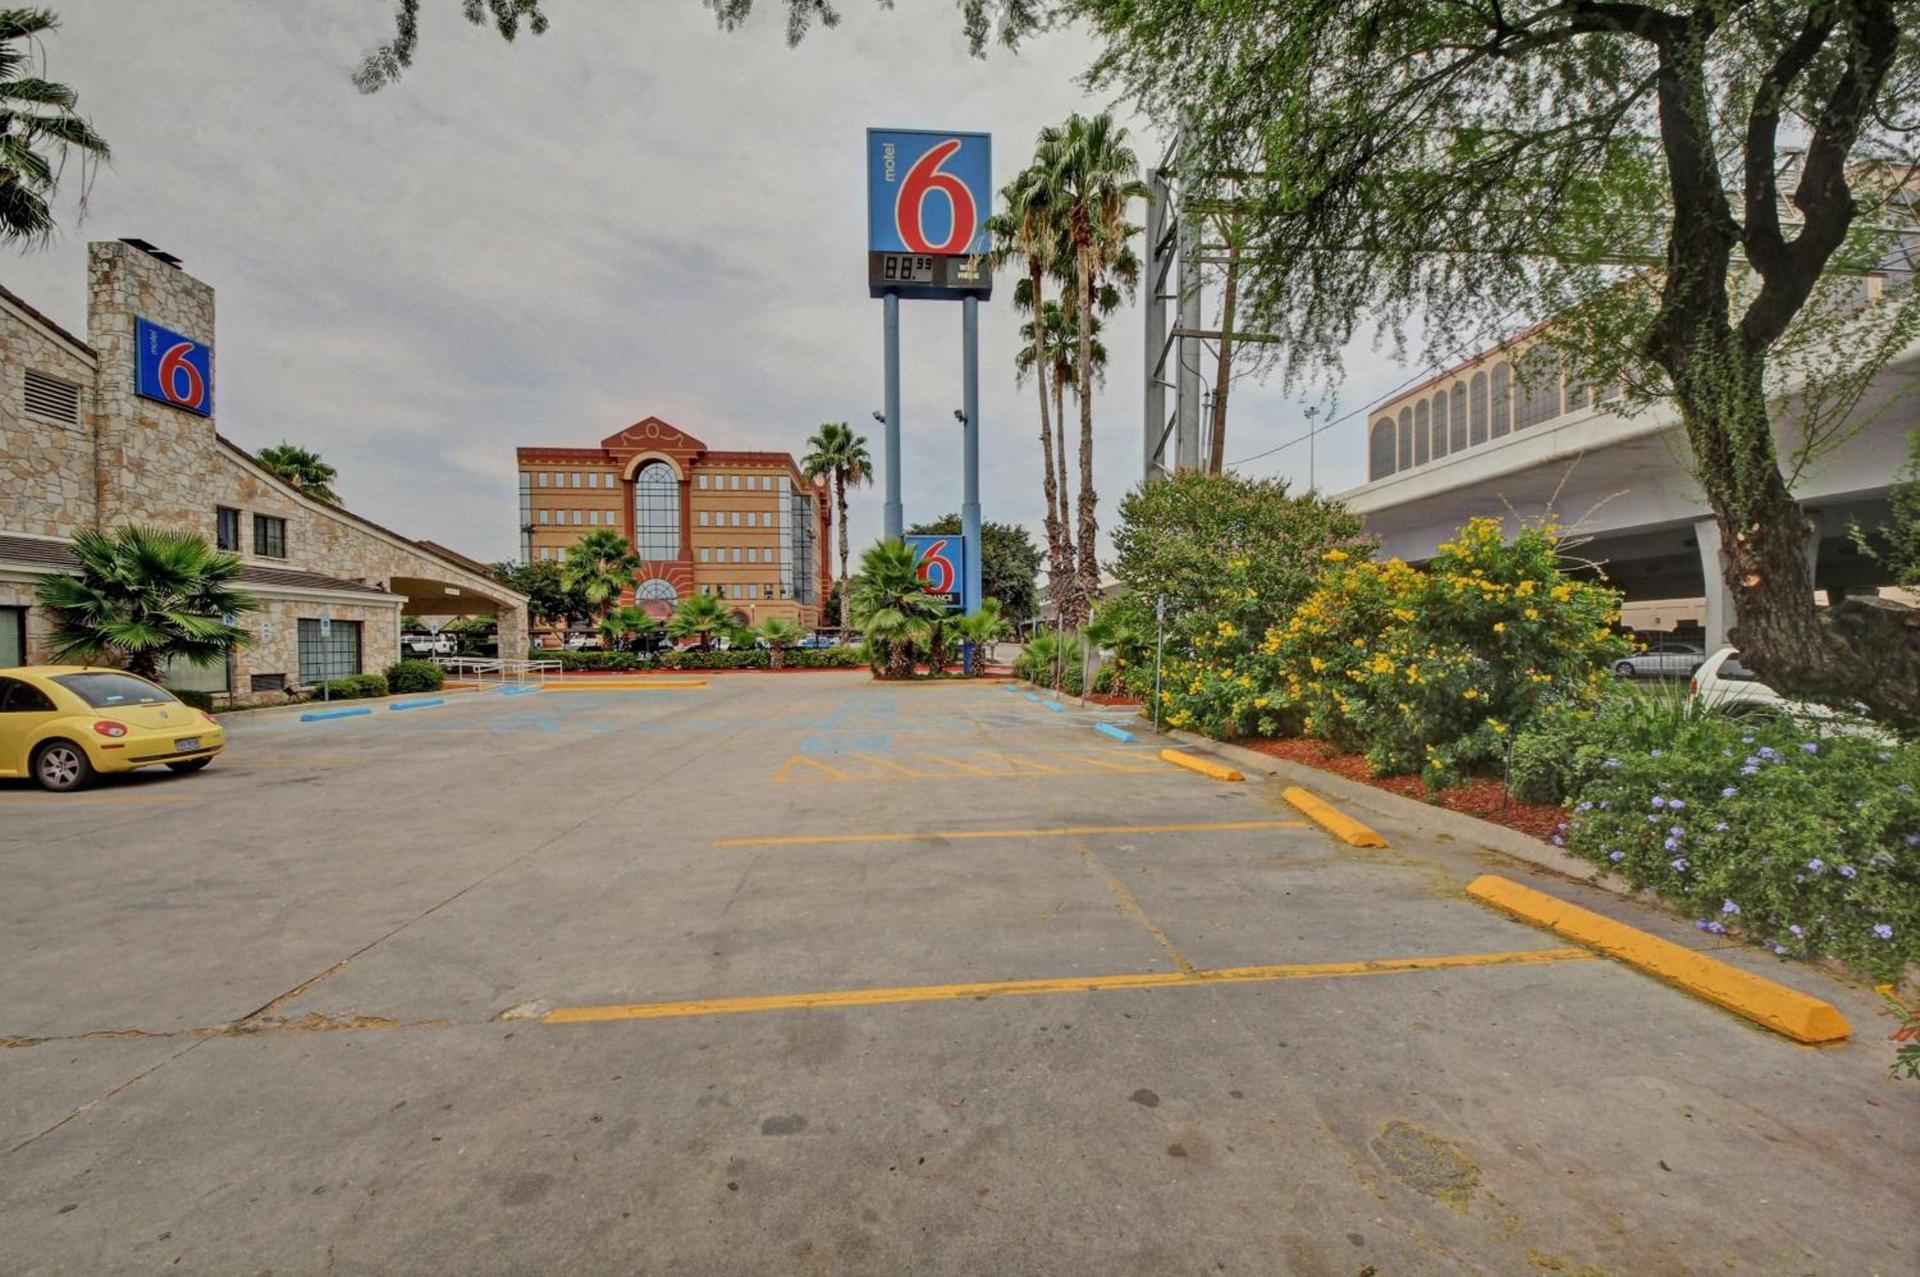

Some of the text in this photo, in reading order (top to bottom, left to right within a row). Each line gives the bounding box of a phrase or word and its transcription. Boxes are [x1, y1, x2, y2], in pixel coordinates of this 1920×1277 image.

[882, 138, 978, 254] motel 6
[158, 342, 205, 409] 6
[915, 539, 956, 594] 6
